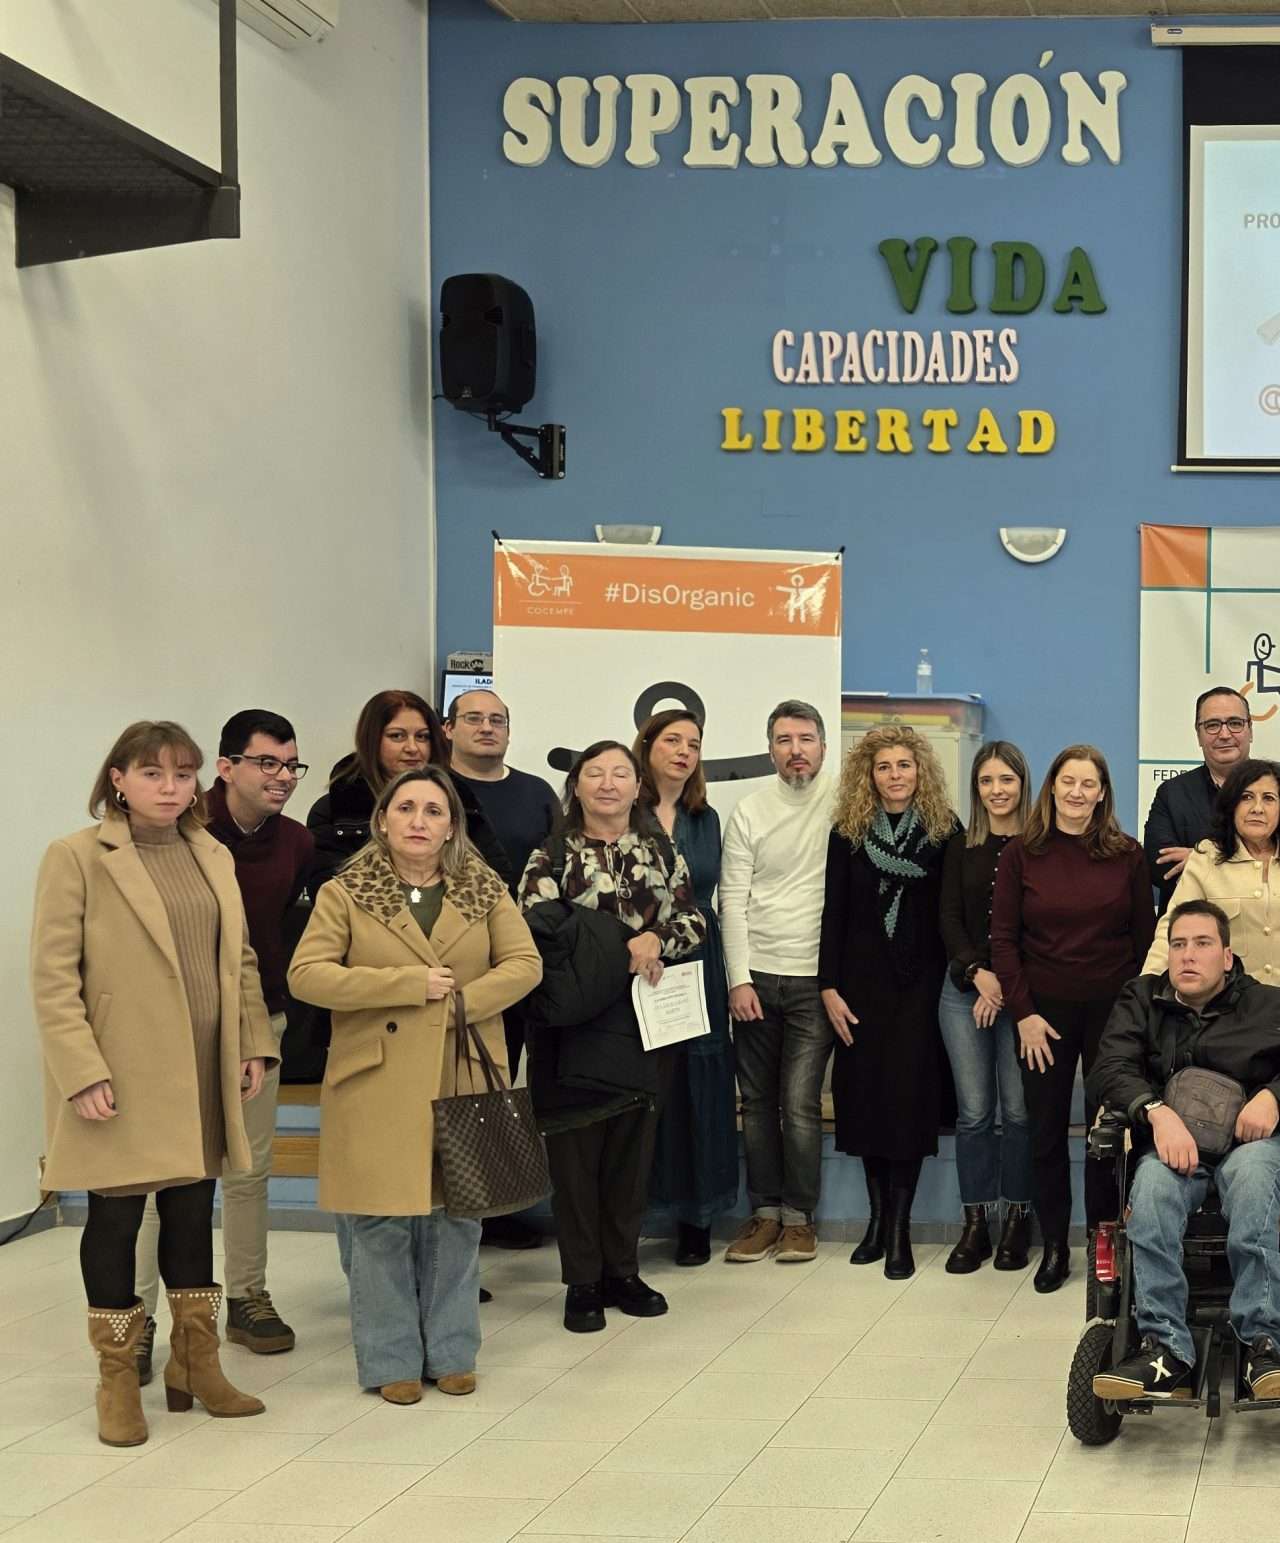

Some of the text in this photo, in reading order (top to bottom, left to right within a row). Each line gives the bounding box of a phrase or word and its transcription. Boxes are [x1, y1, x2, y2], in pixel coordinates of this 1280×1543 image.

[502, 50, 1128, 169] SUPERACIÓN
[878, 236, 1108, 315] VIDA
[772, 329, 1020, 384] CAPACIDADES
[721, 407, 1057, 454] LIBERTAD
[527, 606, 576, 616] COCEMFE
[605, 582, 755, 611] #DisOrganic
